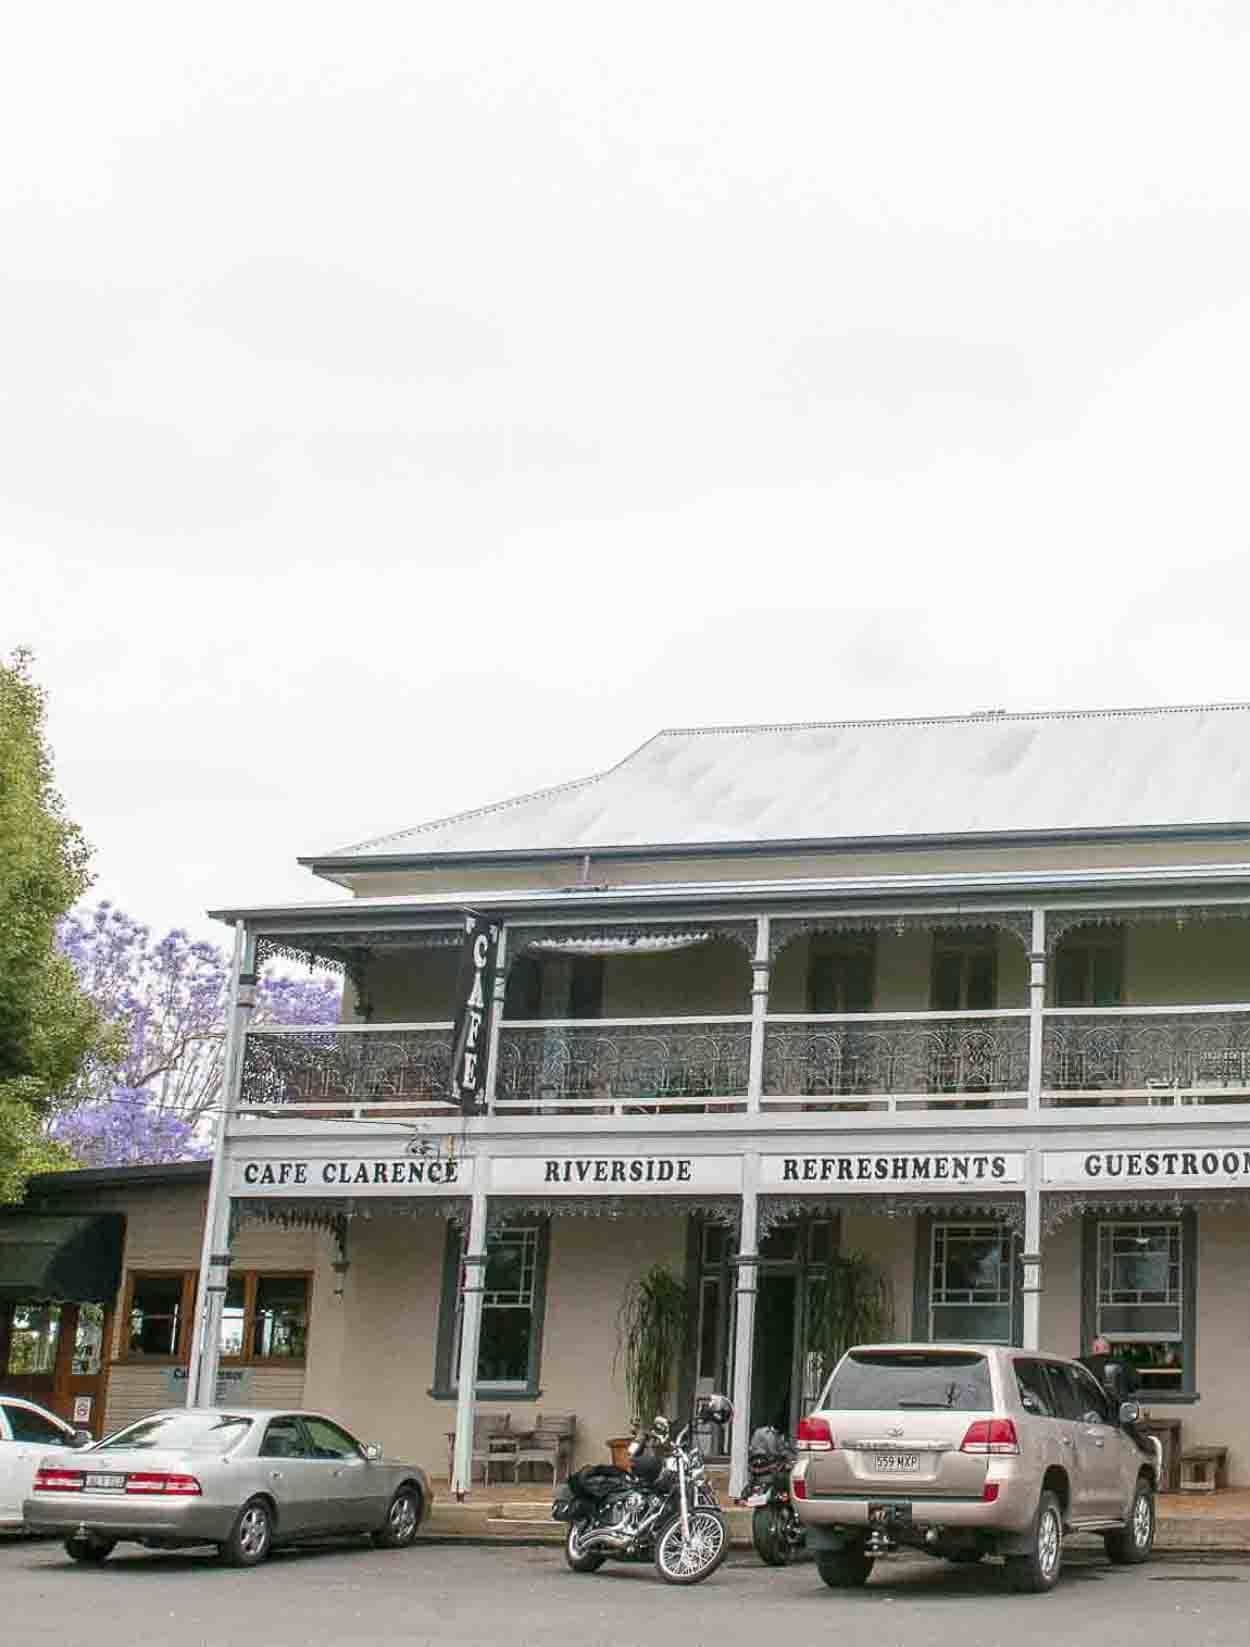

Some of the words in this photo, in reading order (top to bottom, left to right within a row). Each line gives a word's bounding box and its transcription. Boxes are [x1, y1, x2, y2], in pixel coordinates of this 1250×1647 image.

[461, 934, 489, 1091] CAFE
[244, 1160, 307, 1185] CAFE
[322, 1160, 458, 1184] CLARENCE
[544, 1157, 691, 1182] RIVERSIDE
[783, 1156, 1006, 1180] REFRESHMENTS
